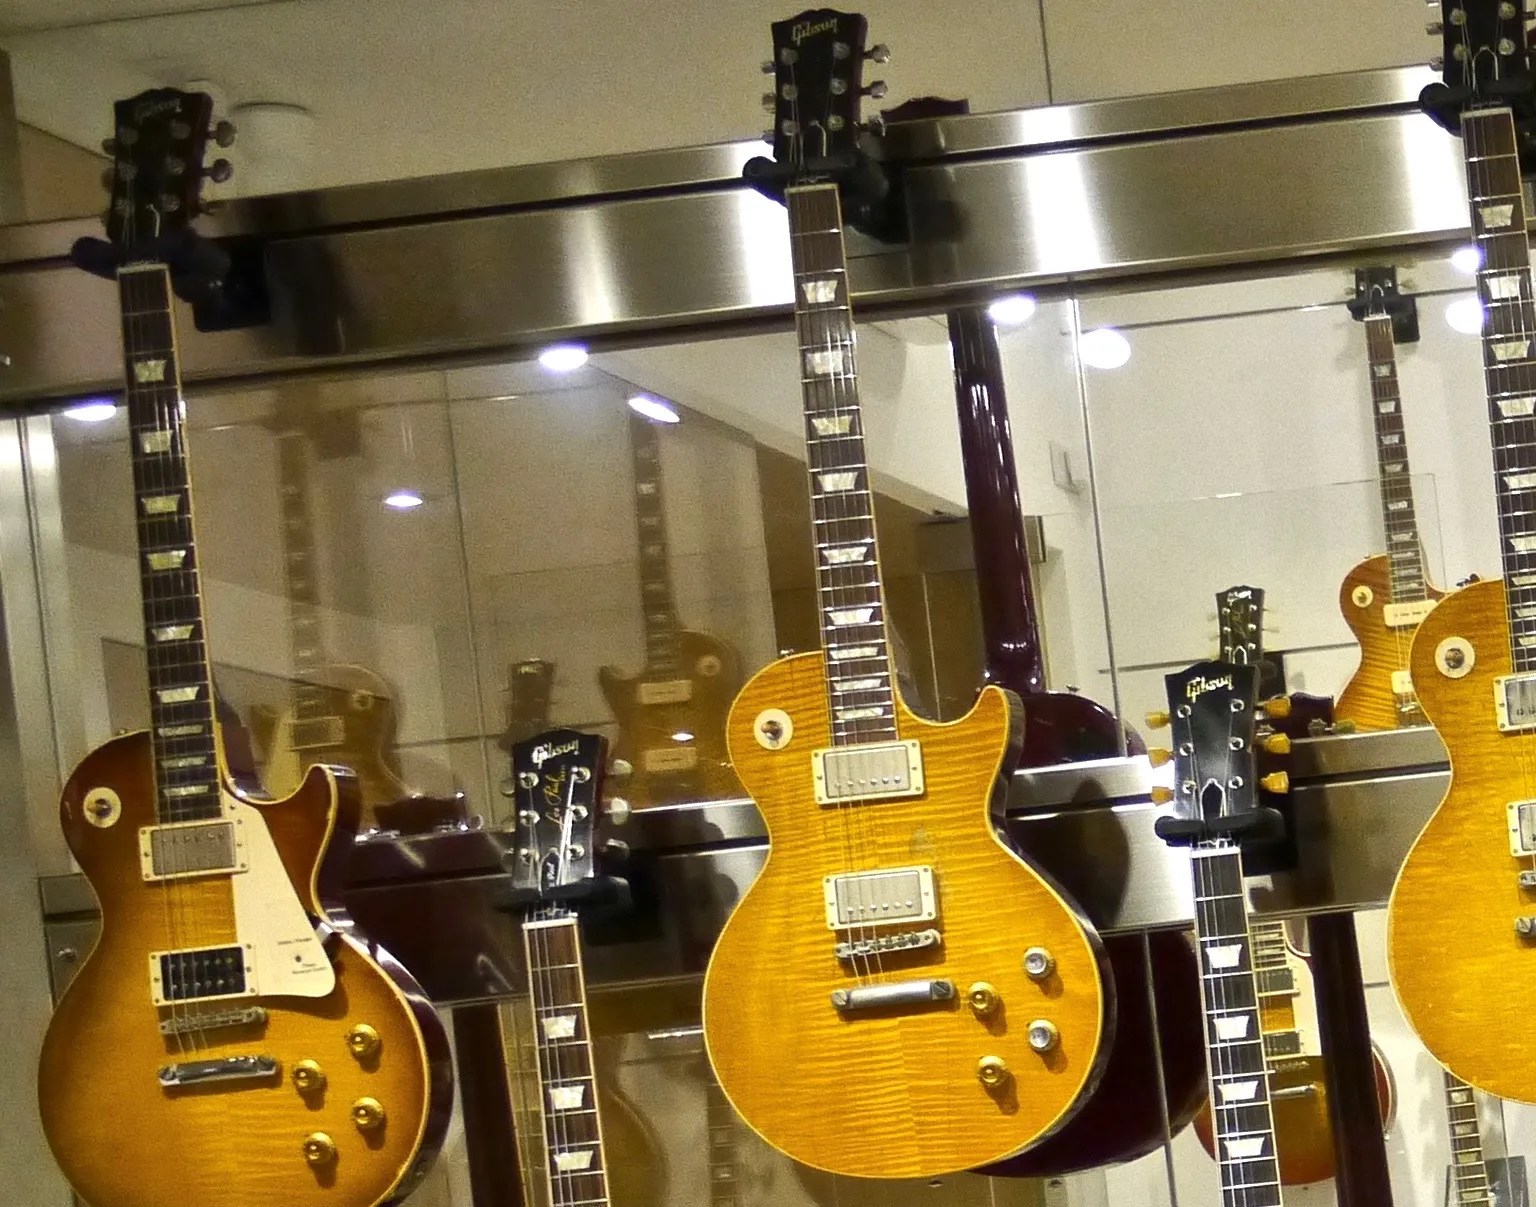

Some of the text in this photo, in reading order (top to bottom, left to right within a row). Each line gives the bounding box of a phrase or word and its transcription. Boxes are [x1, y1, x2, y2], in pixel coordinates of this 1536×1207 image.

[792, 17, 838, 46] Gibson
[1186, 673, 1234, 703] Gibson
[532, 739, 580, 769] Gibson
